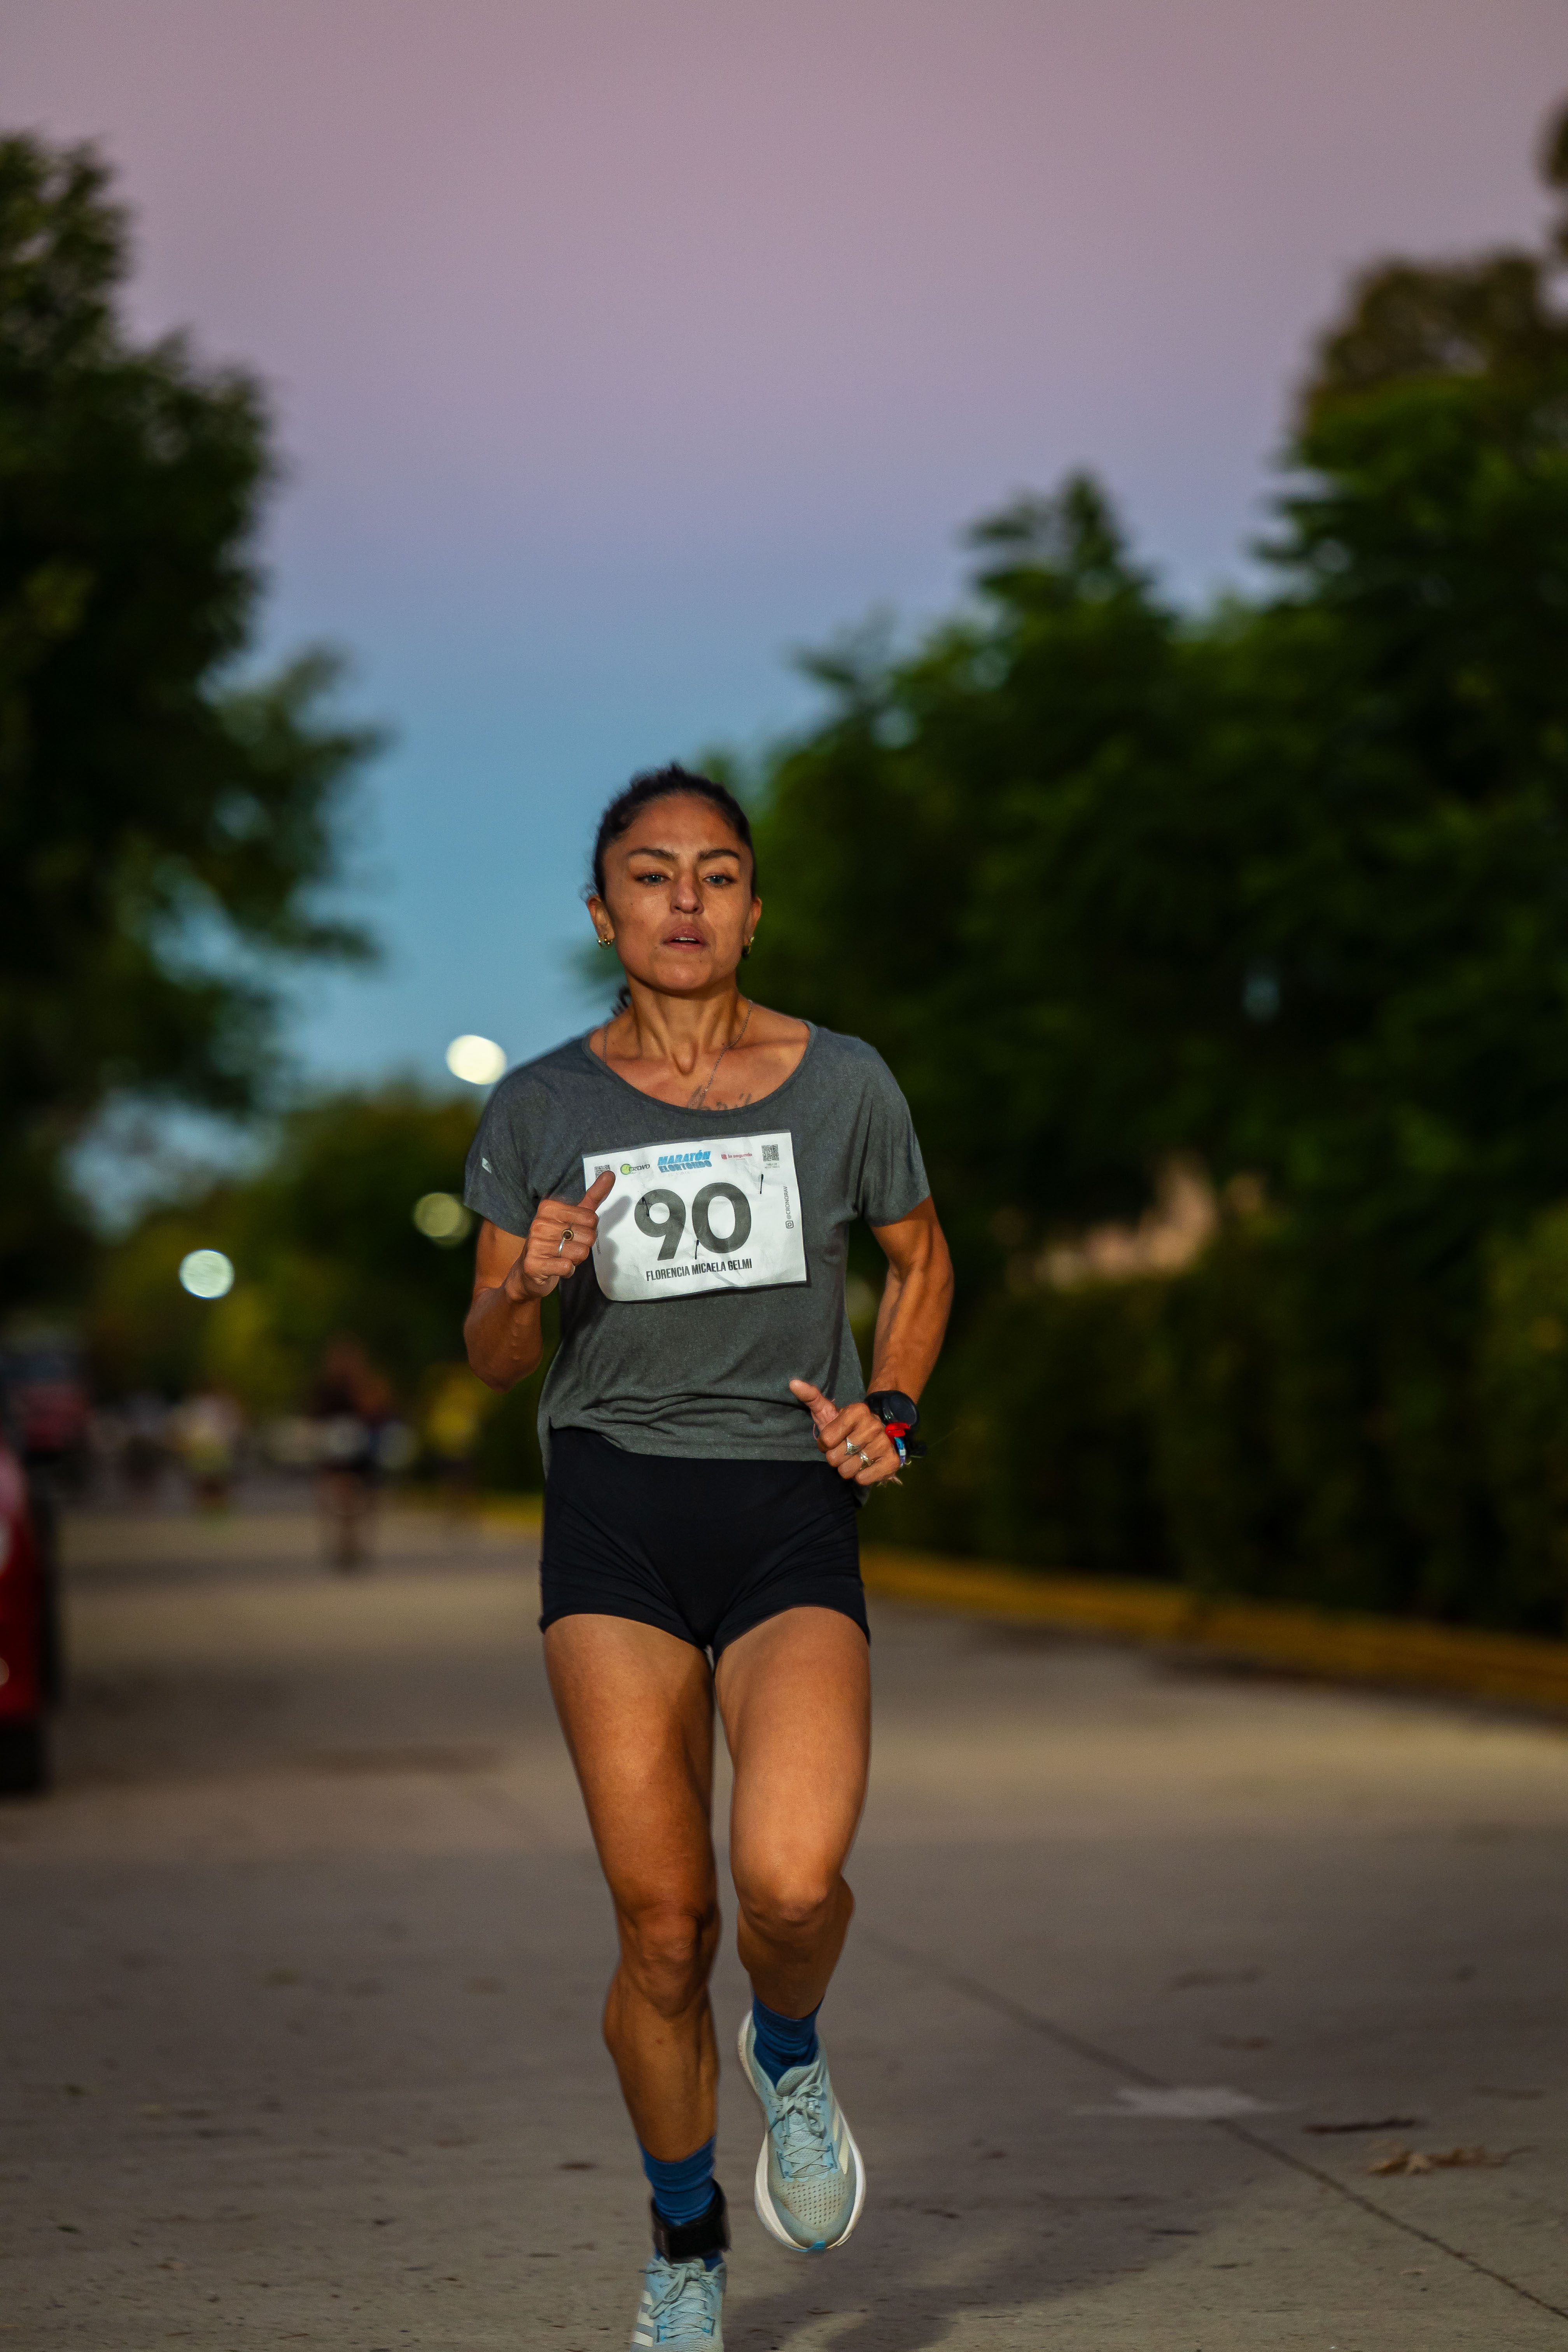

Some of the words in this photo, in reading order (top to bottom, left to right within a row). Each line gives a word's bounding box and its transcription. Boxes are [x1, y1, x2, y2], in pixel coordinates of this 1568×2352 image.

[658, 1150, 711, 1166] MARATÓN
[783, 1186, 791, 1219] @CRONORAV
[634, 1182, 751, 1261] 90
[646, 1266, 690, 1281] FLORENCIA
[691, 1262, 726, 1275] MICAELA
[728, 1258, 752, 1270] GELMI
